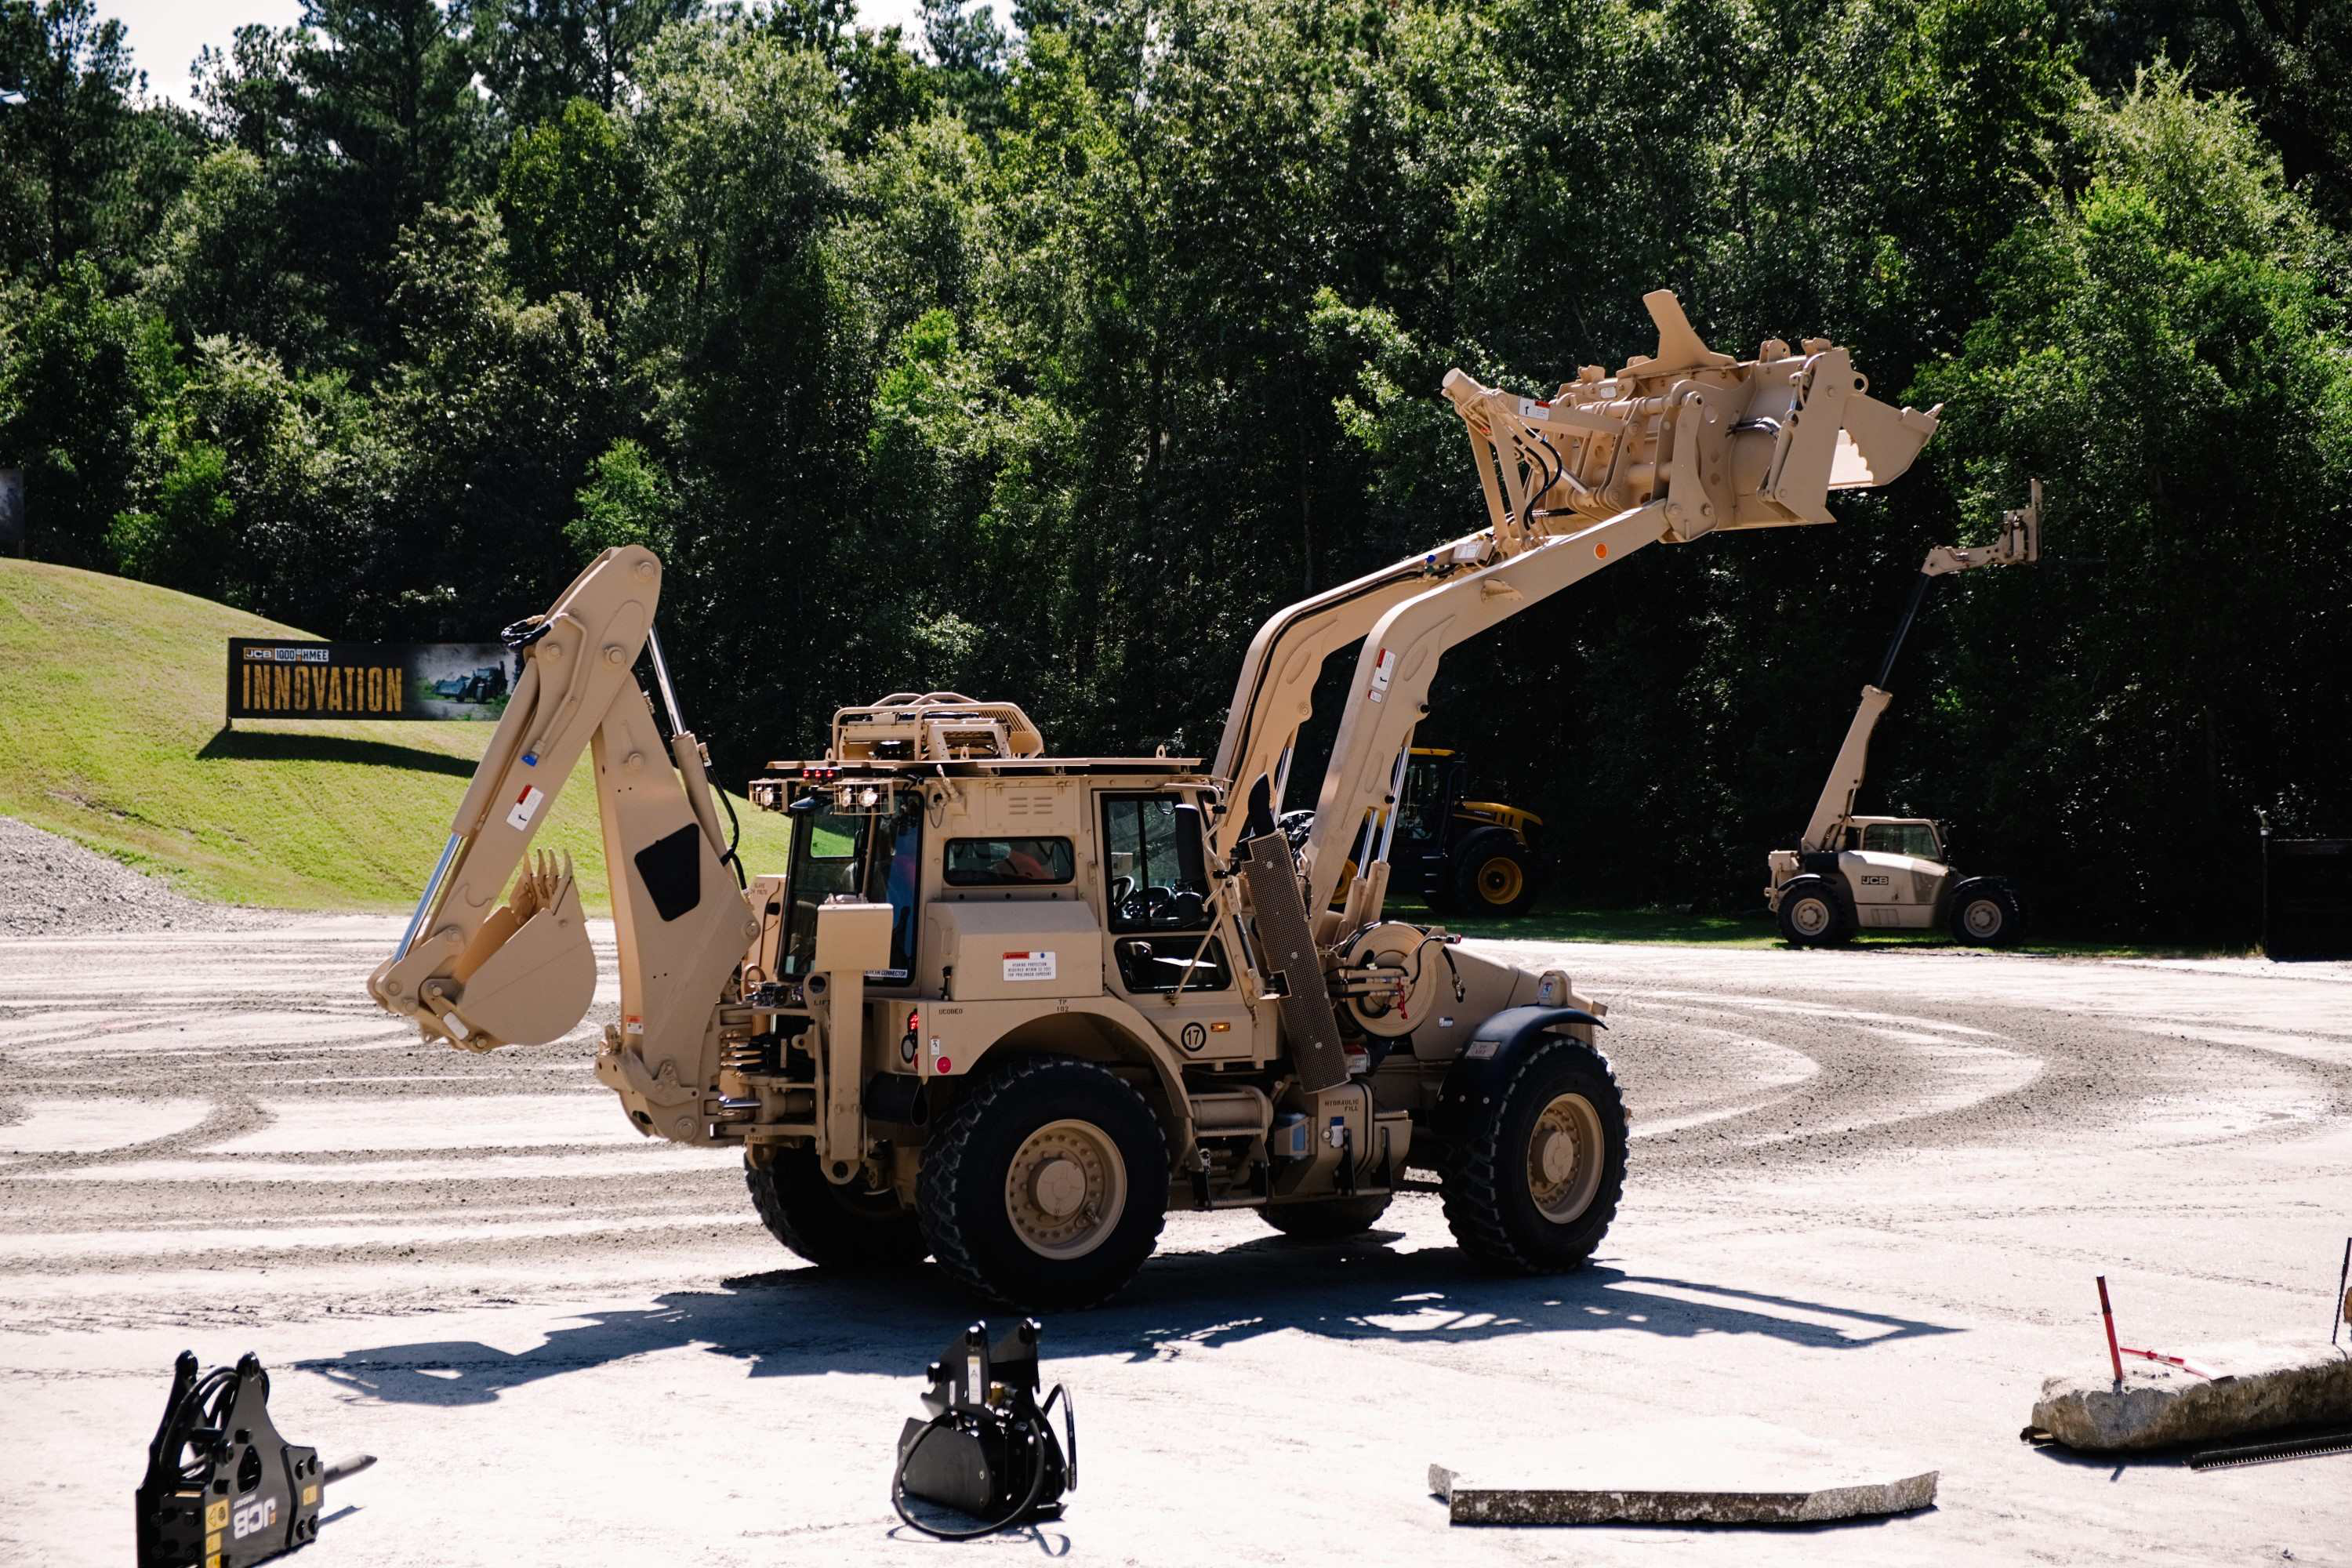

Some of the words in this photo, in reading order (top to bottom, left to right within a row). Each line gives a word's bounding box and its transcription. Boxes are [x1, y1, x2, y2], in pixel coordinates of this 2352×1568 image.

[245, 649, 273, 659] JCB
[303, 650, 327, 660] HMEE
[242, 664, 402, 712] INNOVATION
[1186, 1029, 1200, 1046] 17
[234, 1496, 276, 1541] JCB
